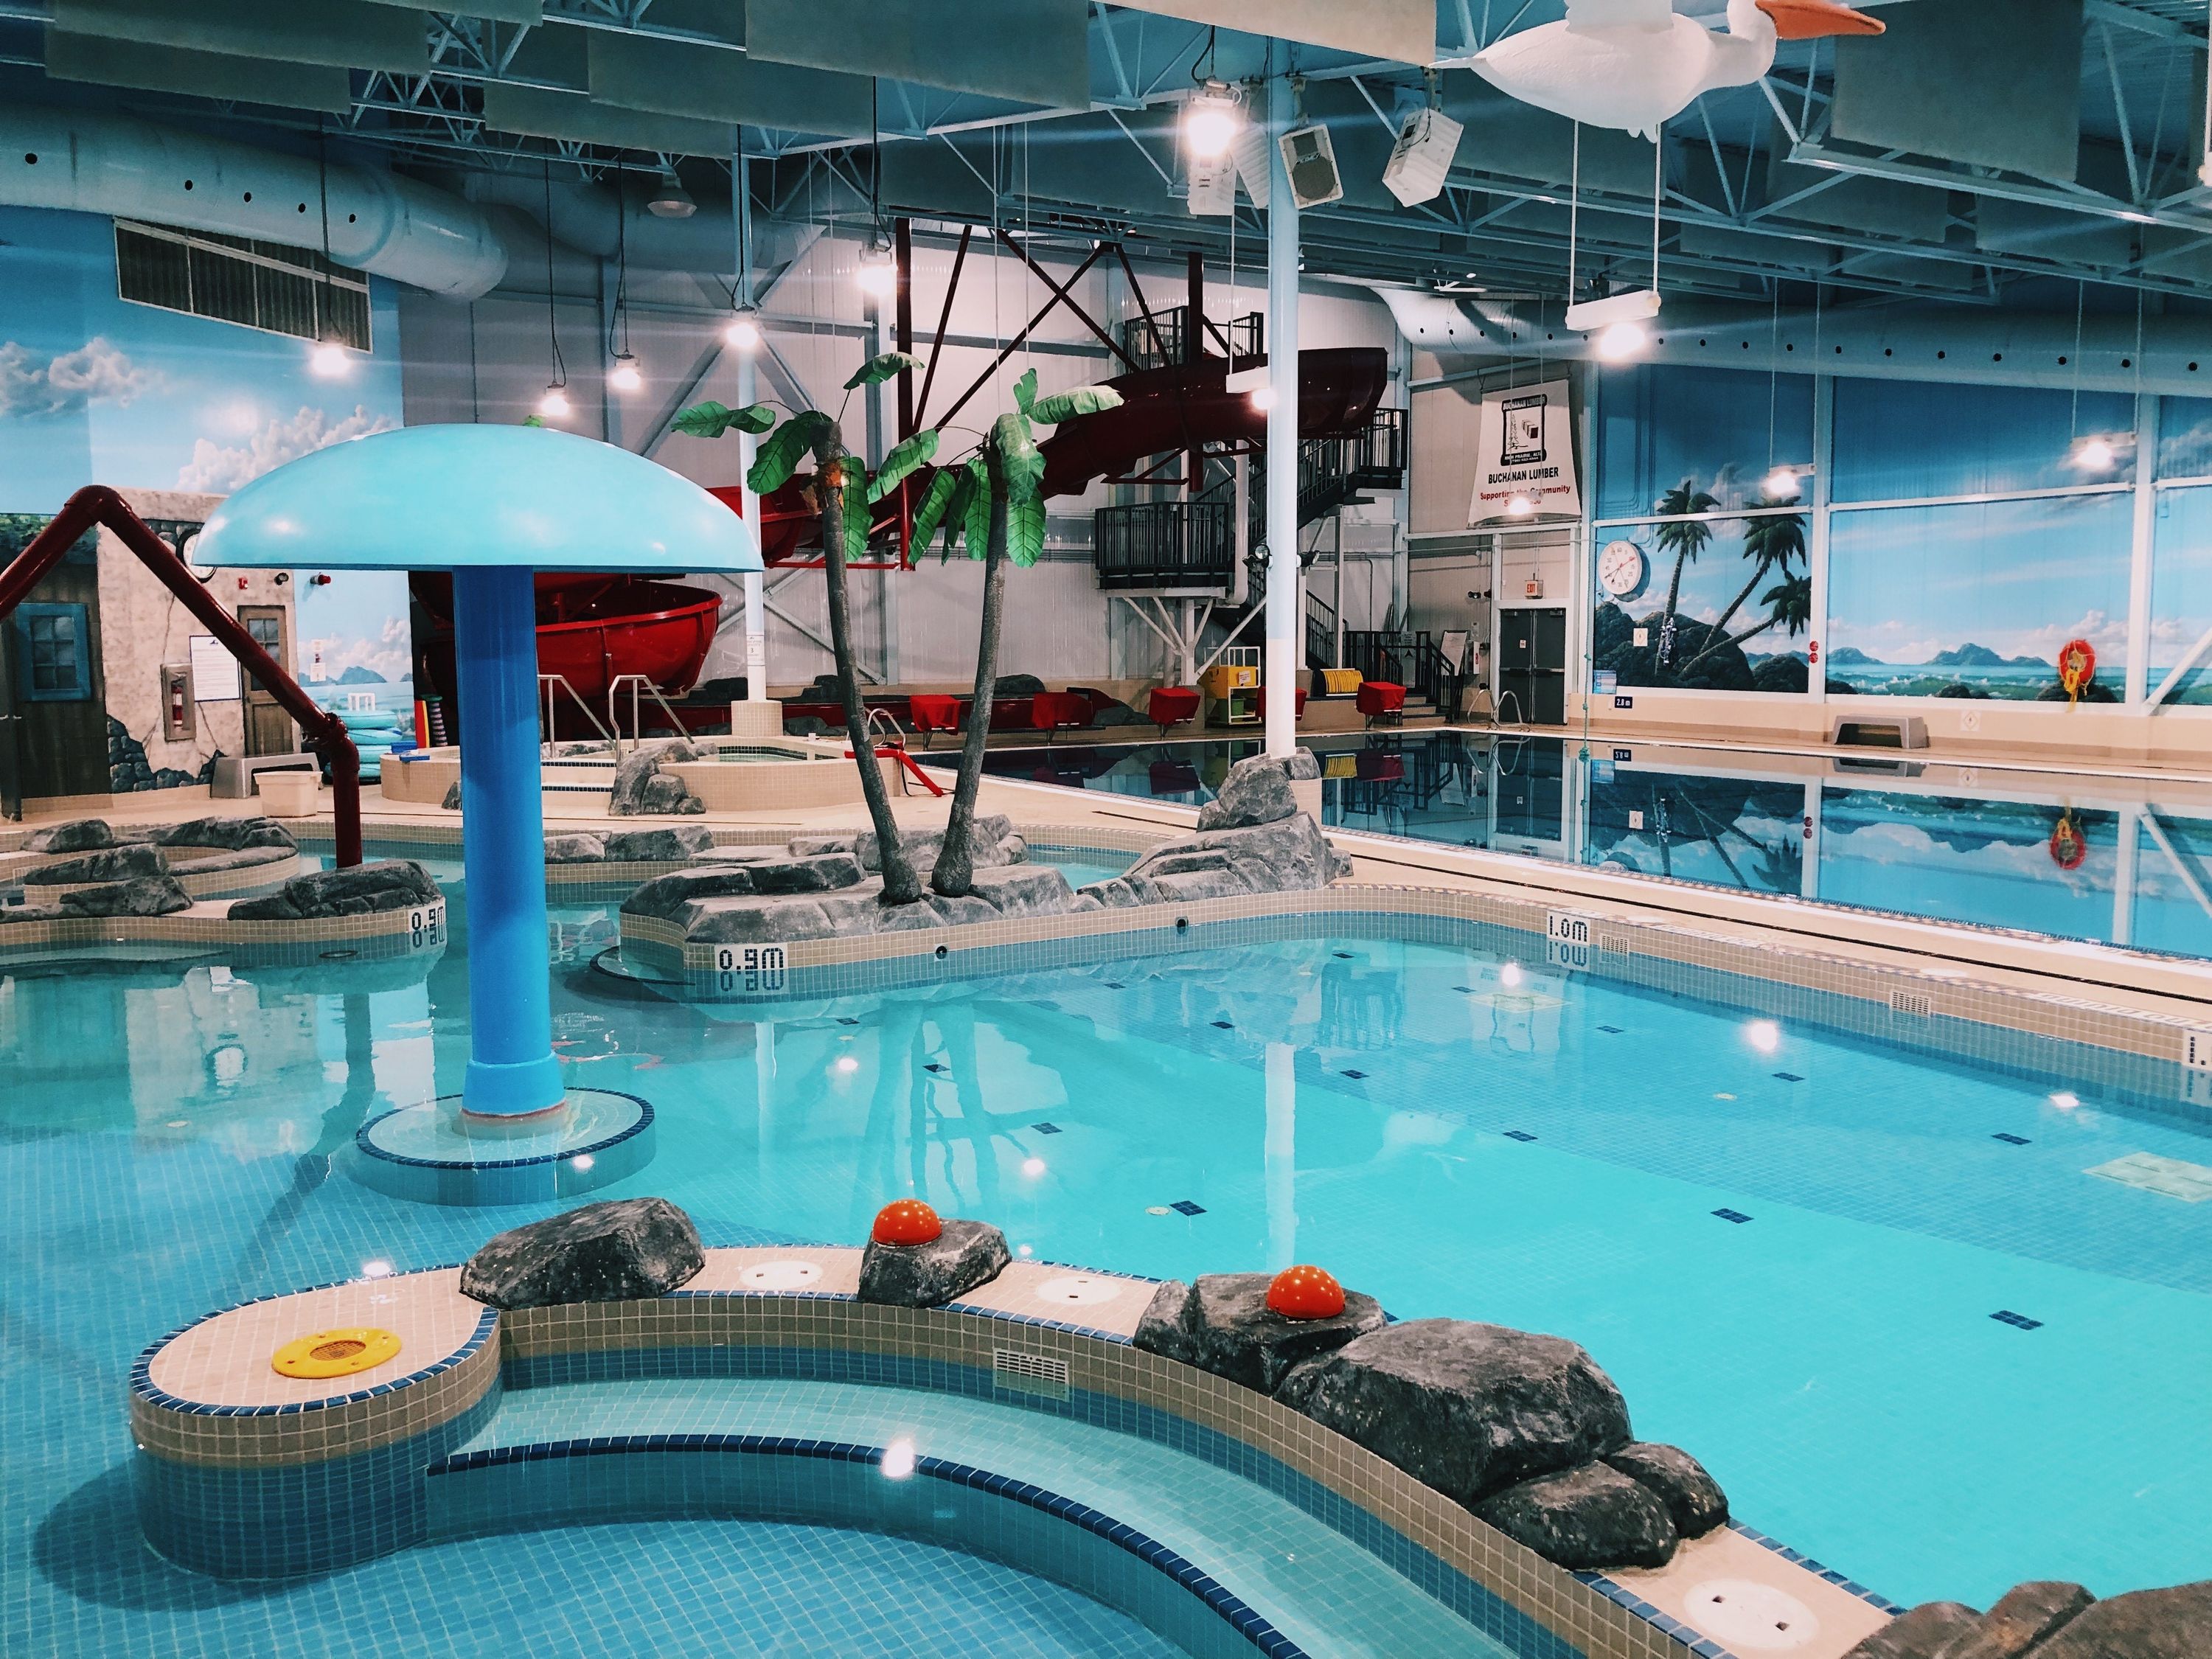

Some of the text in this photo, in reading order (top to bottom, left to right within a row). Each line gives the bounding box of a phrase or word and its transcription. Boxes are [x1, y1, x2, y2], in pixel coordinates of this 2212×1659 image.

[1488, 467, 1559, 484] BUCHANAN LUMBER
[1527, 583, 1535, 593] EXIT
